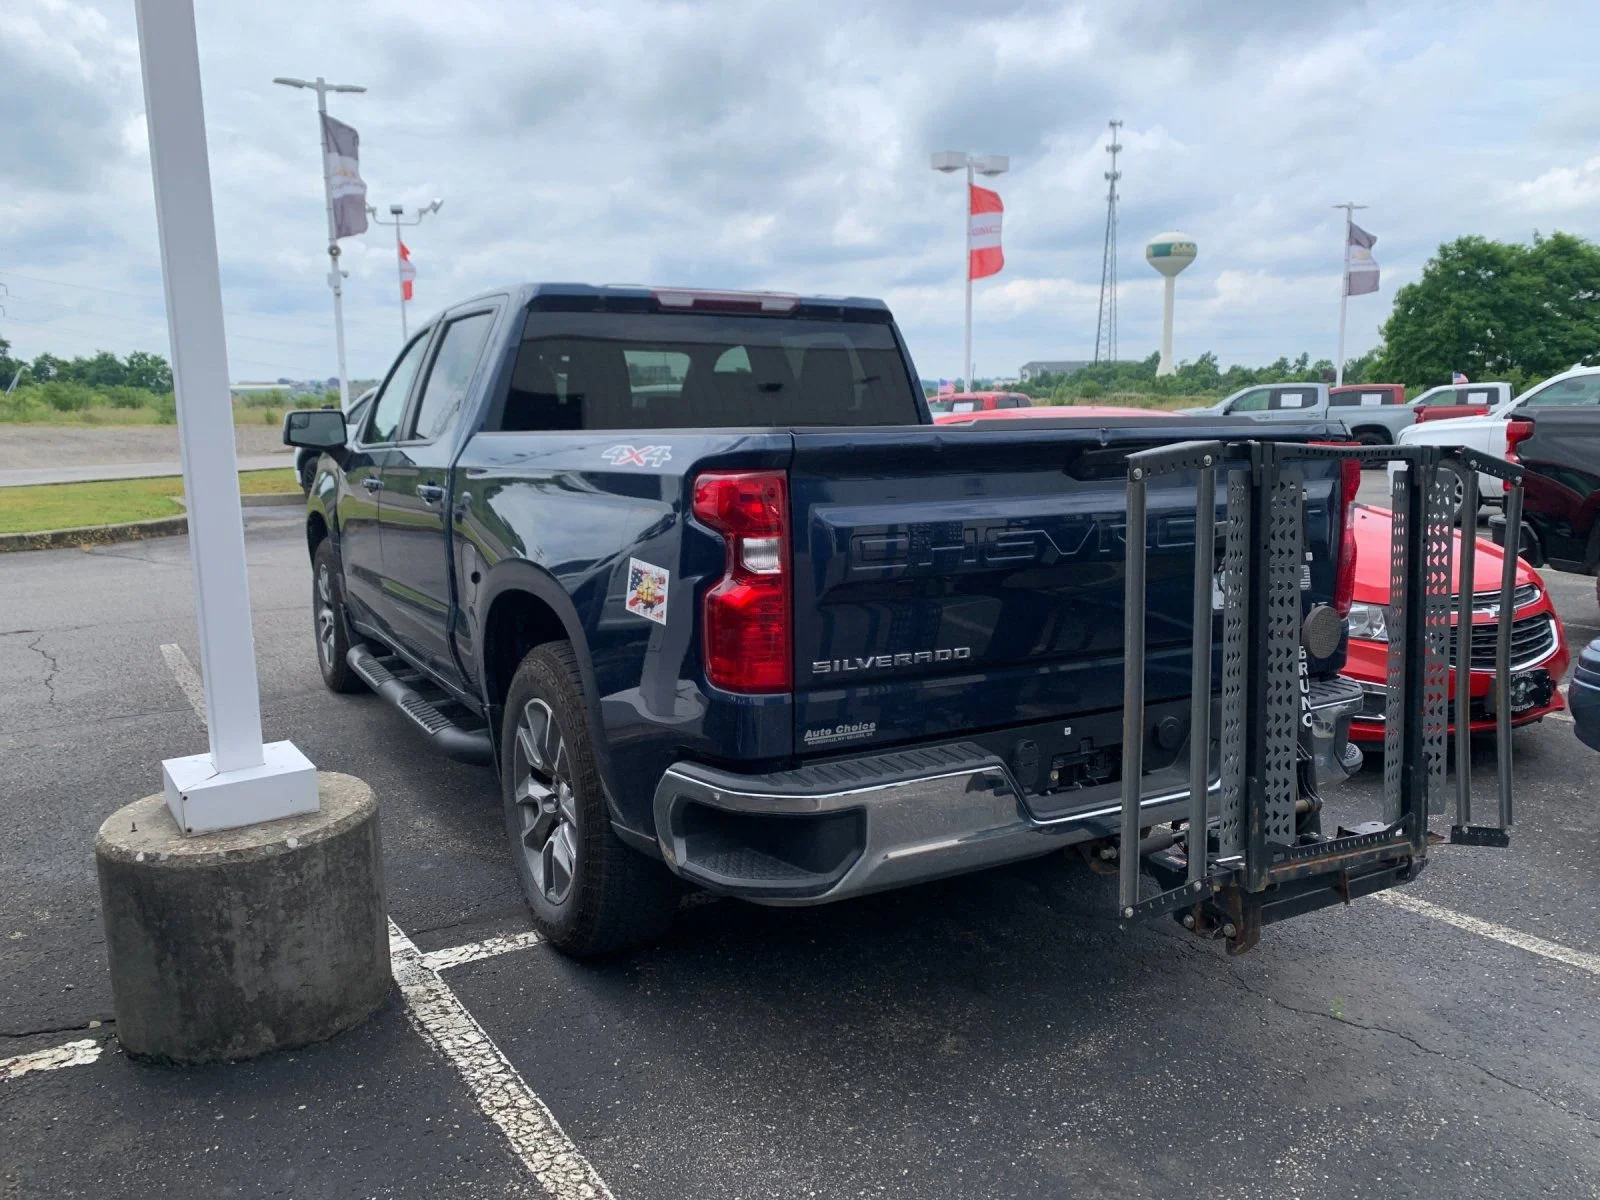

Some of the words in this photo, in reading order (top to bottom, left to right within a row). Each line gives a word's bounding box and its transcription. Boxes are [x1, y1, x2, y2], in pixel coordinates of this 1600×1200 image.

[812, 647, 971, 674] SILVERADO
[1299, 645, 1313, 728] BRUNO
[804, 728, 832, 739] Auto
[835, 721, 876, 734] Choice
